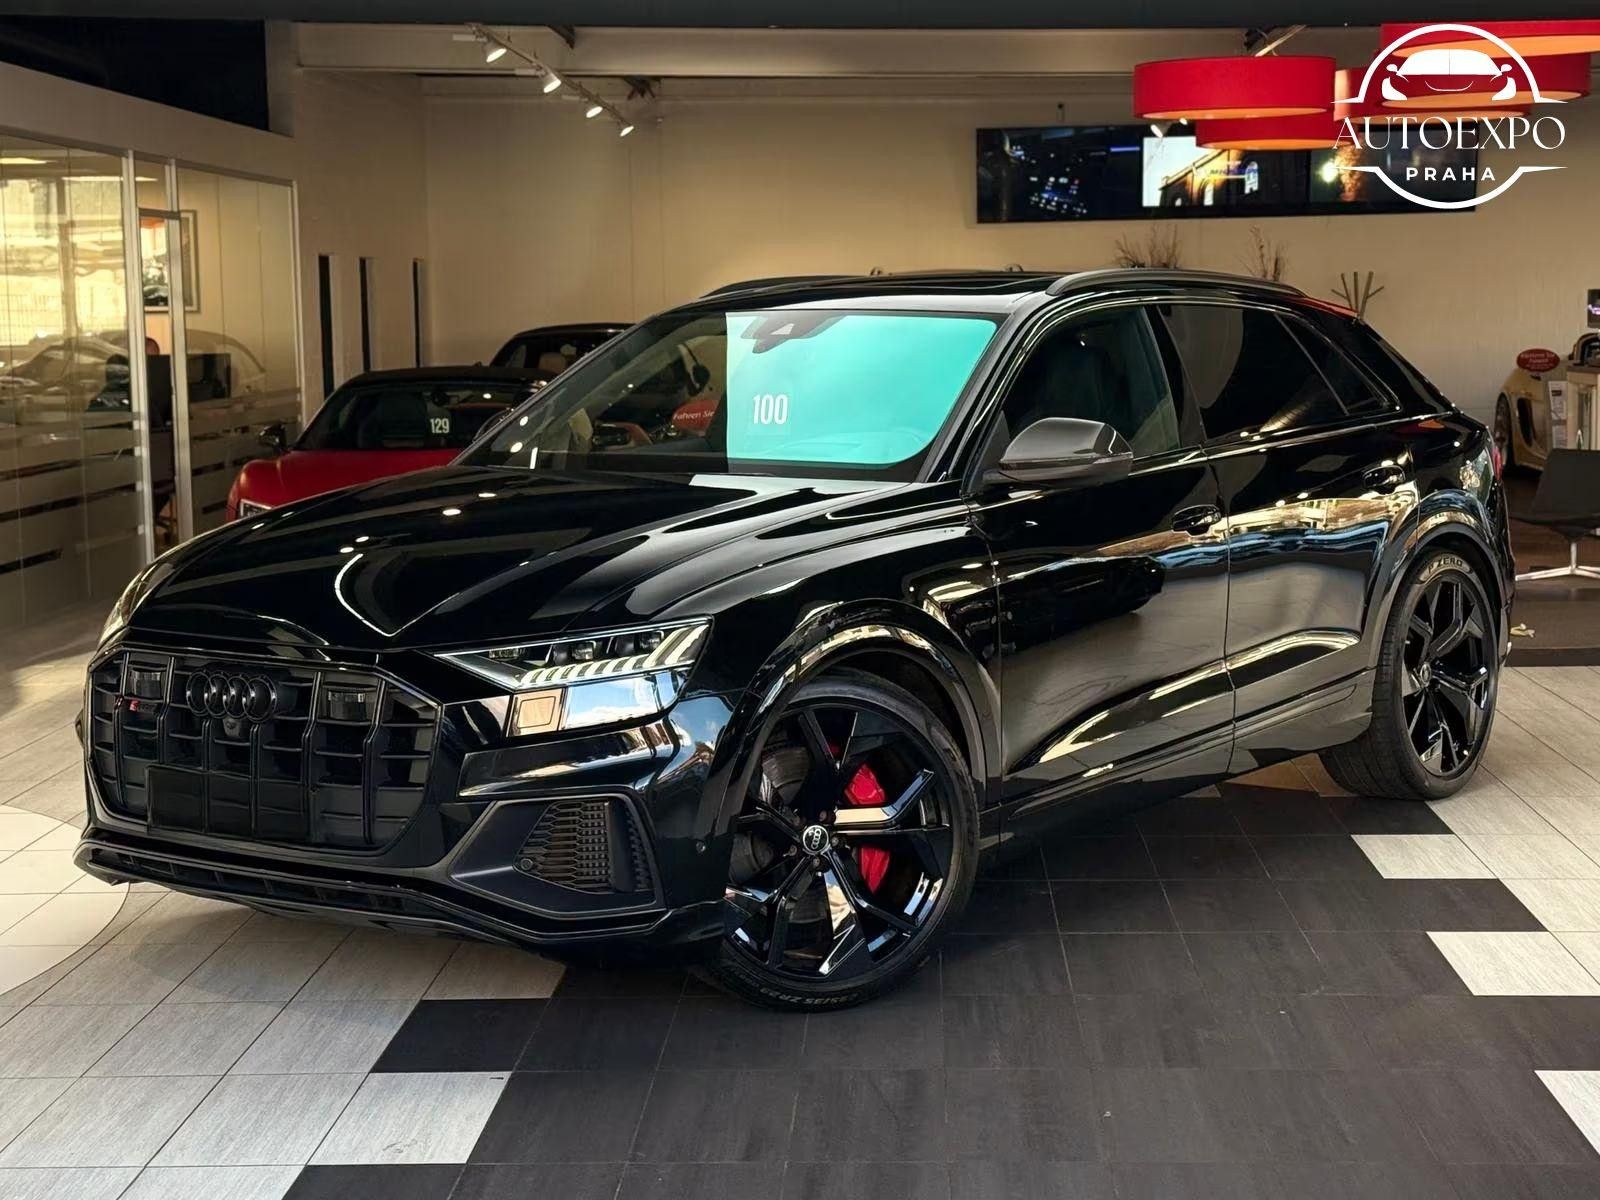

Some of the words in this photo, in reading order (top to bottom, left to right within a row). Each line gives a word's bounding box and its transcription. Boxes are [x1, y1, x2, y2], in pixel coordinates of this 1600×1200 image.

[753, 394, 789, 425] 100
[430, 417, 450, 434] 129
[1437, 556, 1463, 567] ZERO
